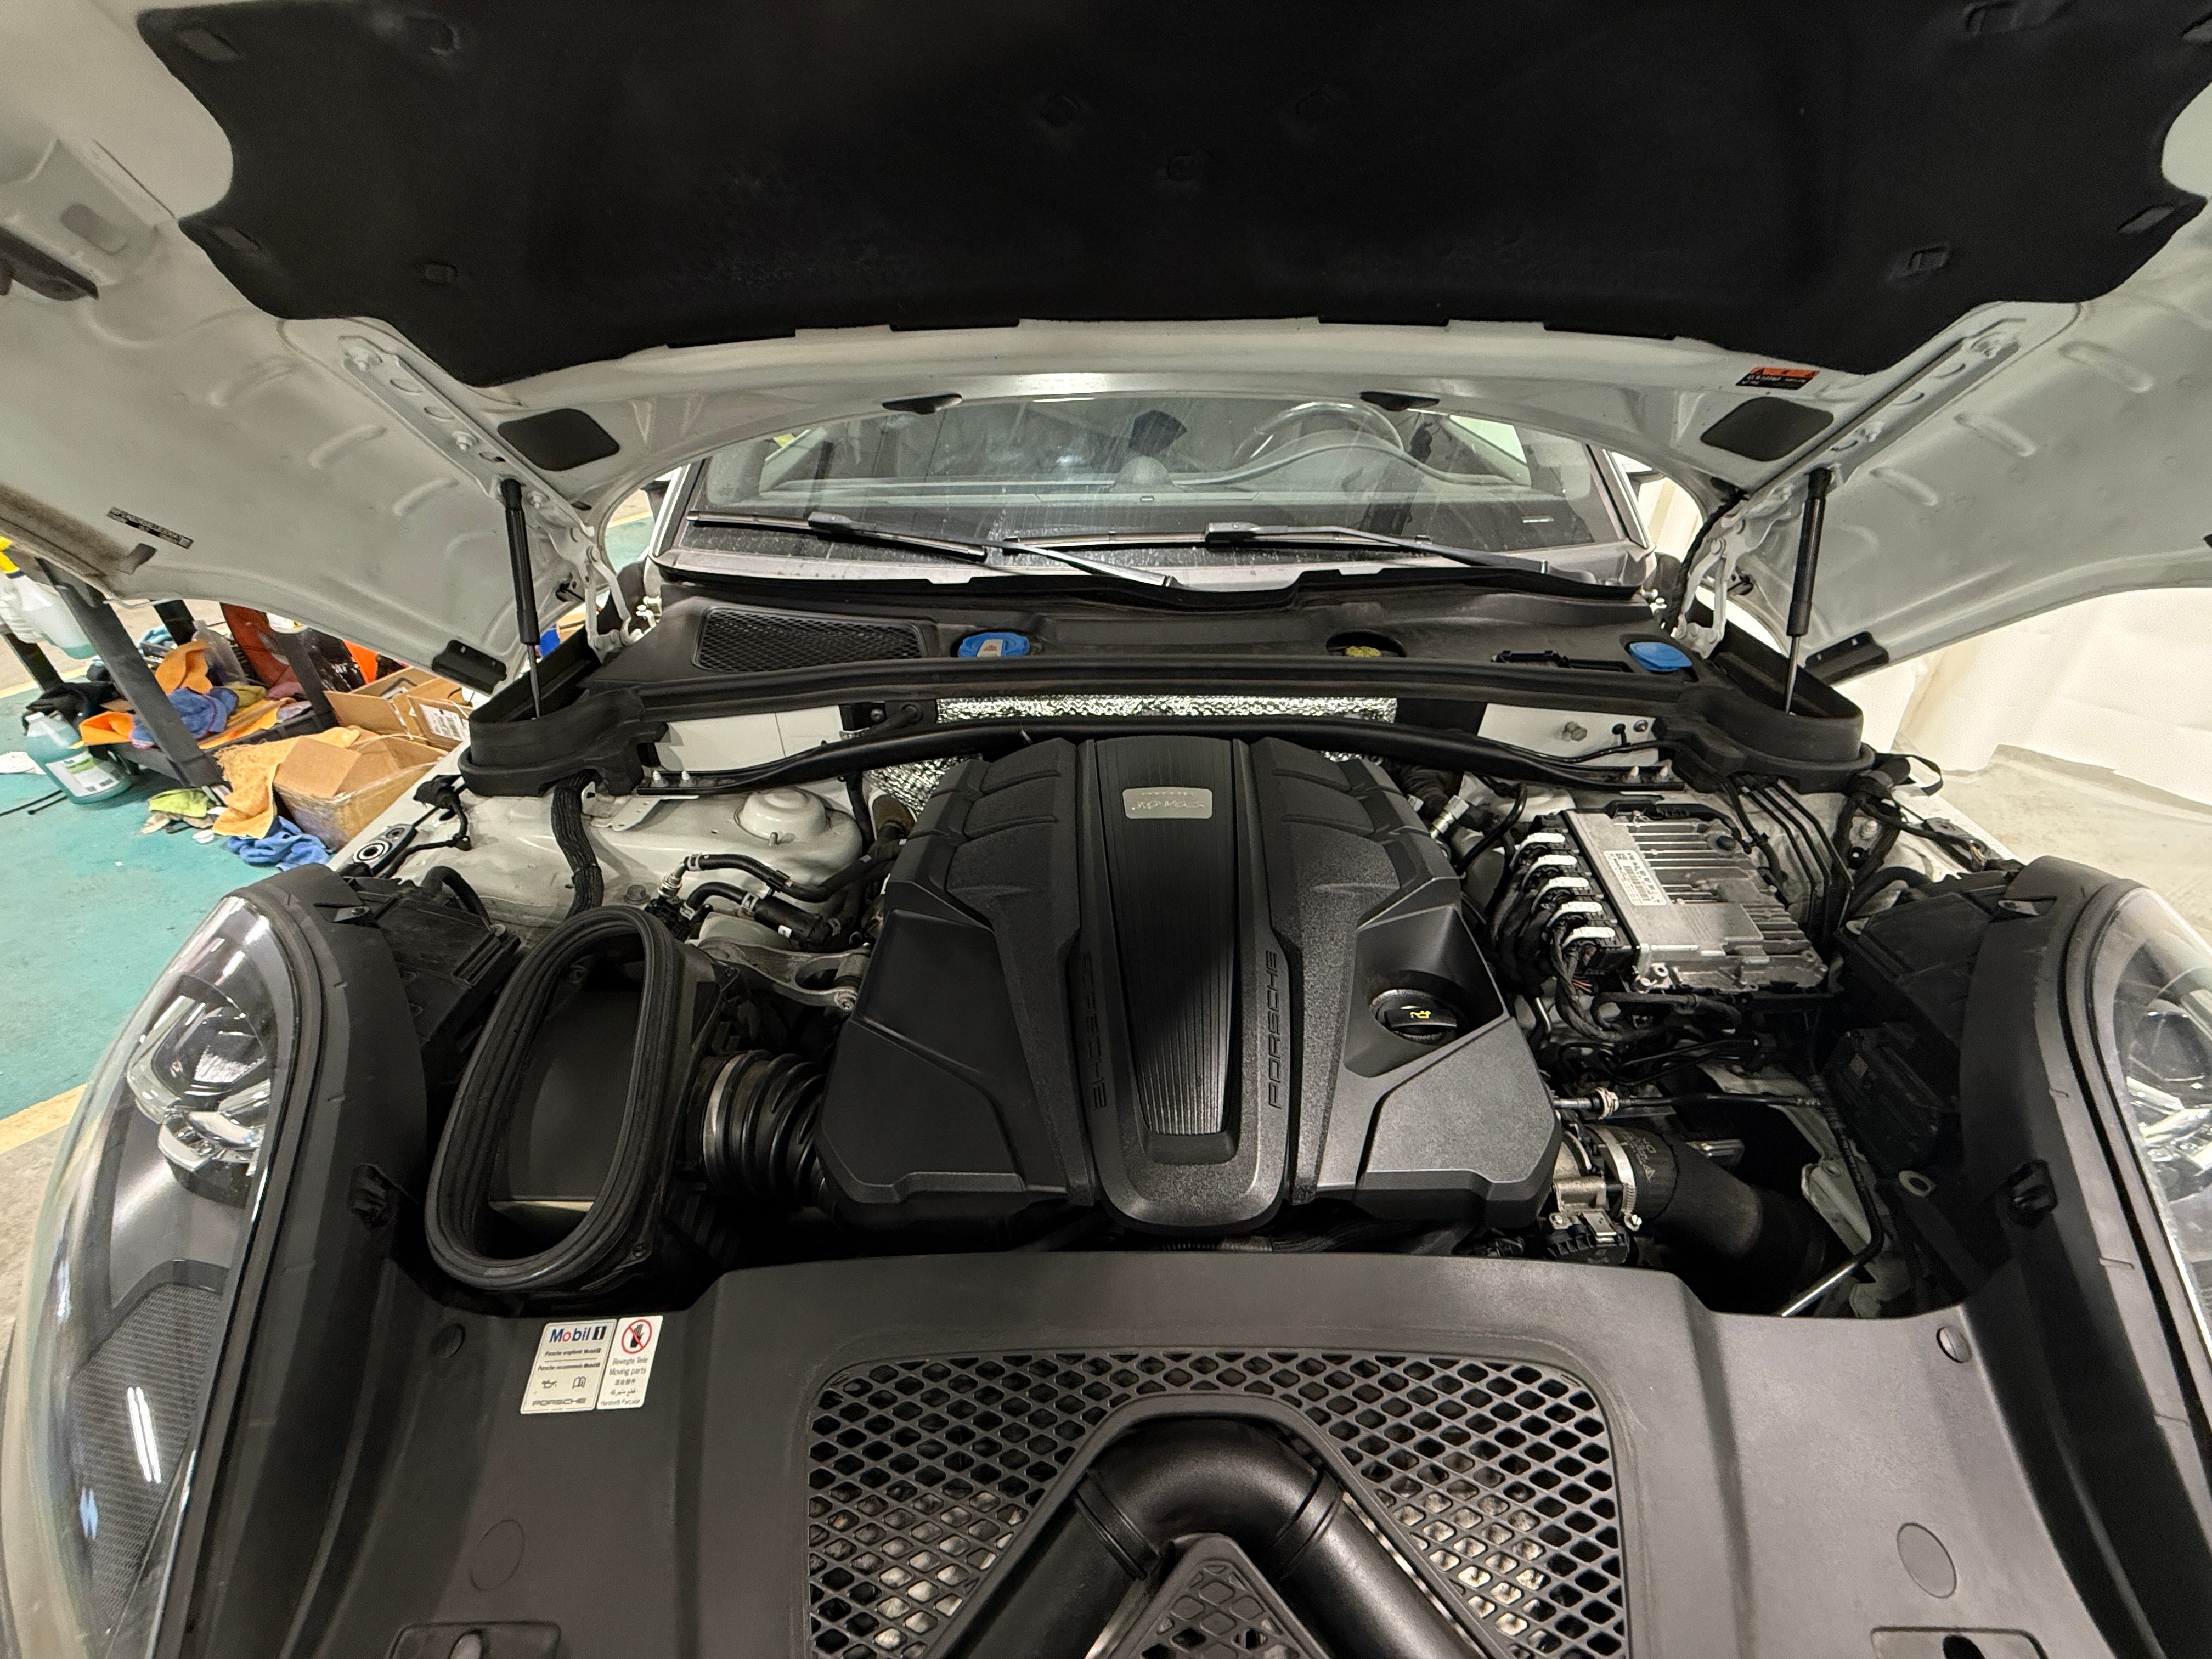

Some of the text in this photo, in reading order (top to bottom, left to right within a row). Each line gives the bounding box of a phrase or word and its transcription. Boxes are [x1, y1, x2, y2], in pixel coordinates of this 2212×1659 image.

[1266, 949, 1282, 1110] PORSCHE
[549, 1327, 591, 1343] Mobil
[609, 1367, 646, 1376] Moving parts
